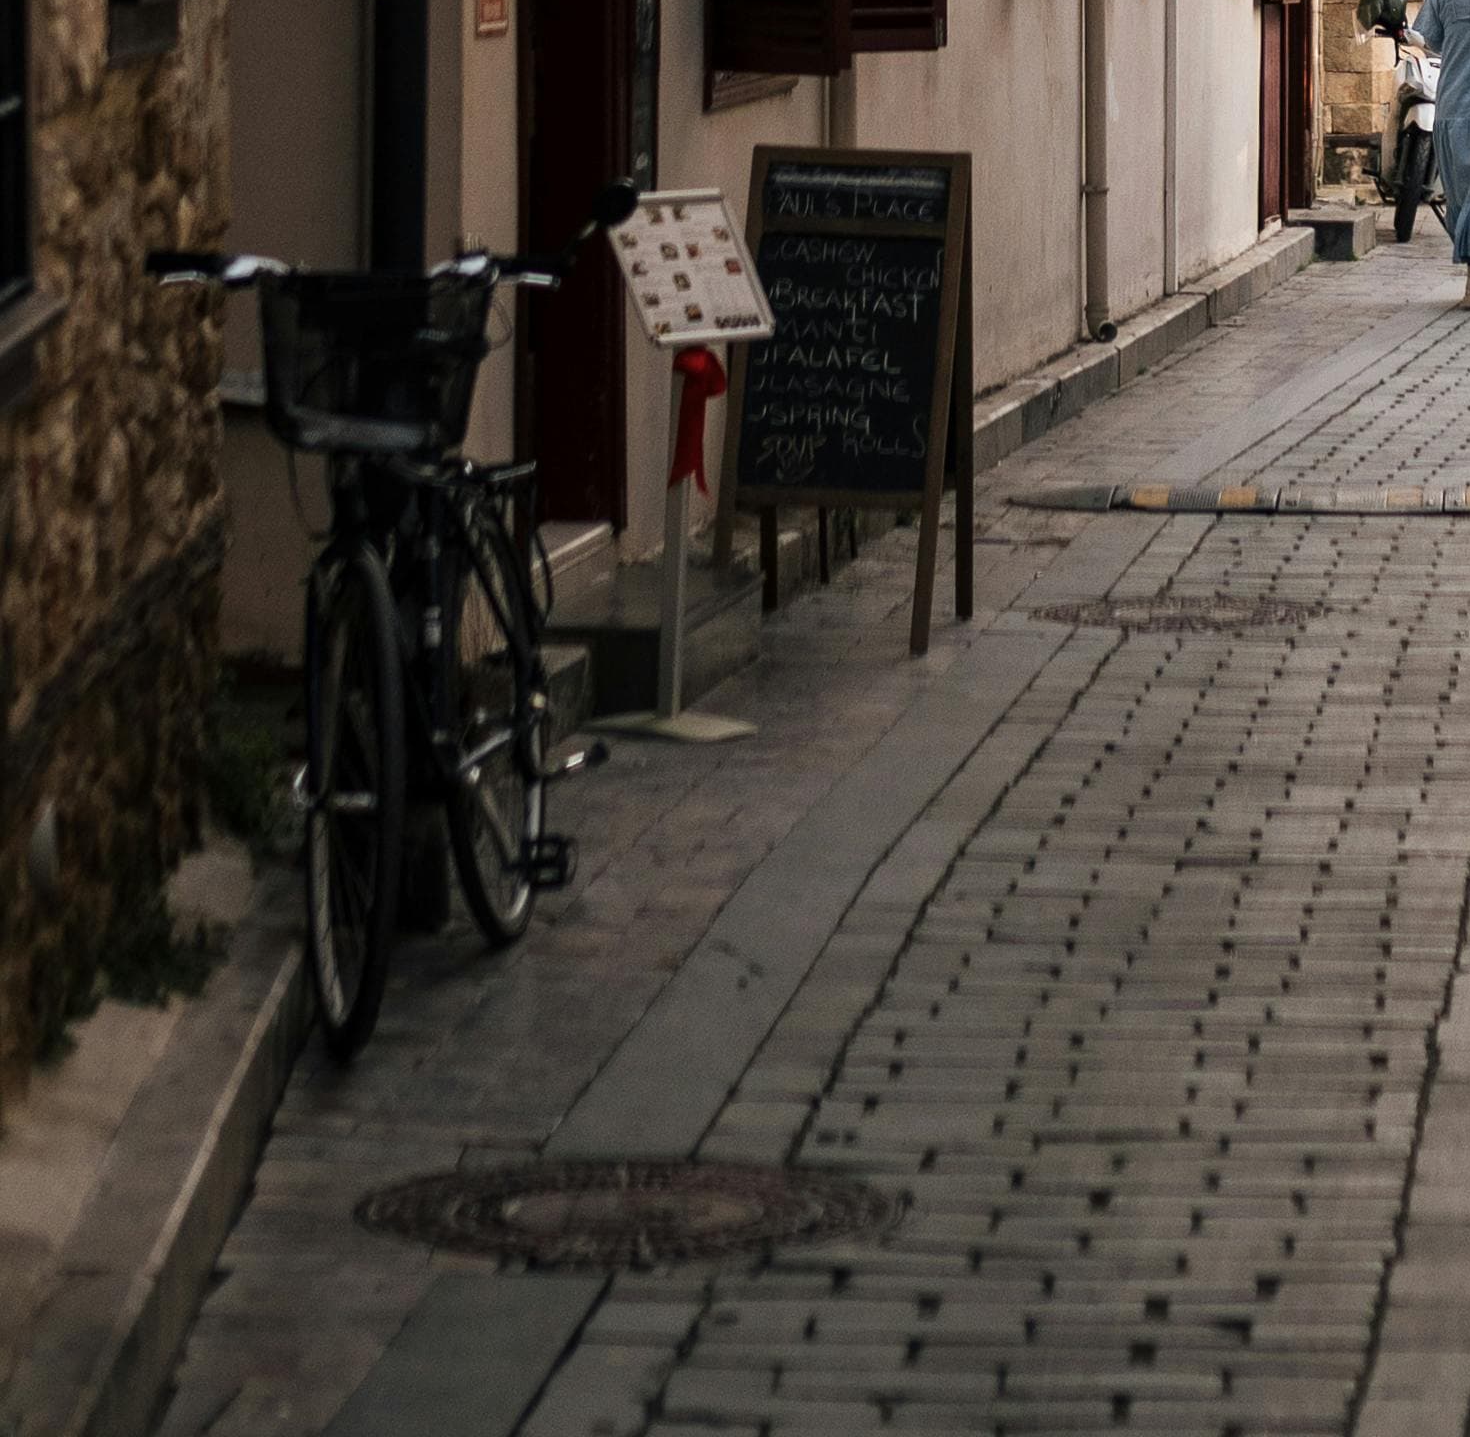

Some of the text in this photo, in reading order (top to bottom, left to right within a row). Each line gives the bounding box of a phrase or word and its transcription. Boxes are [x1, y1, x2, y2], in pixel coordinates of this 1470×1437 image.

[853, 187, 935, 222] PLACE
[780, 239, 878, 264] CASHEW
[846, 249, 945, 289] CHICKEN
[774, 277, 926, 322] BREAKFAST
[772, 345, 902, 375] FALAFEL
[769, 374, 910, 405] LASAGNE
[769, 402, 871, 436] SPRING
